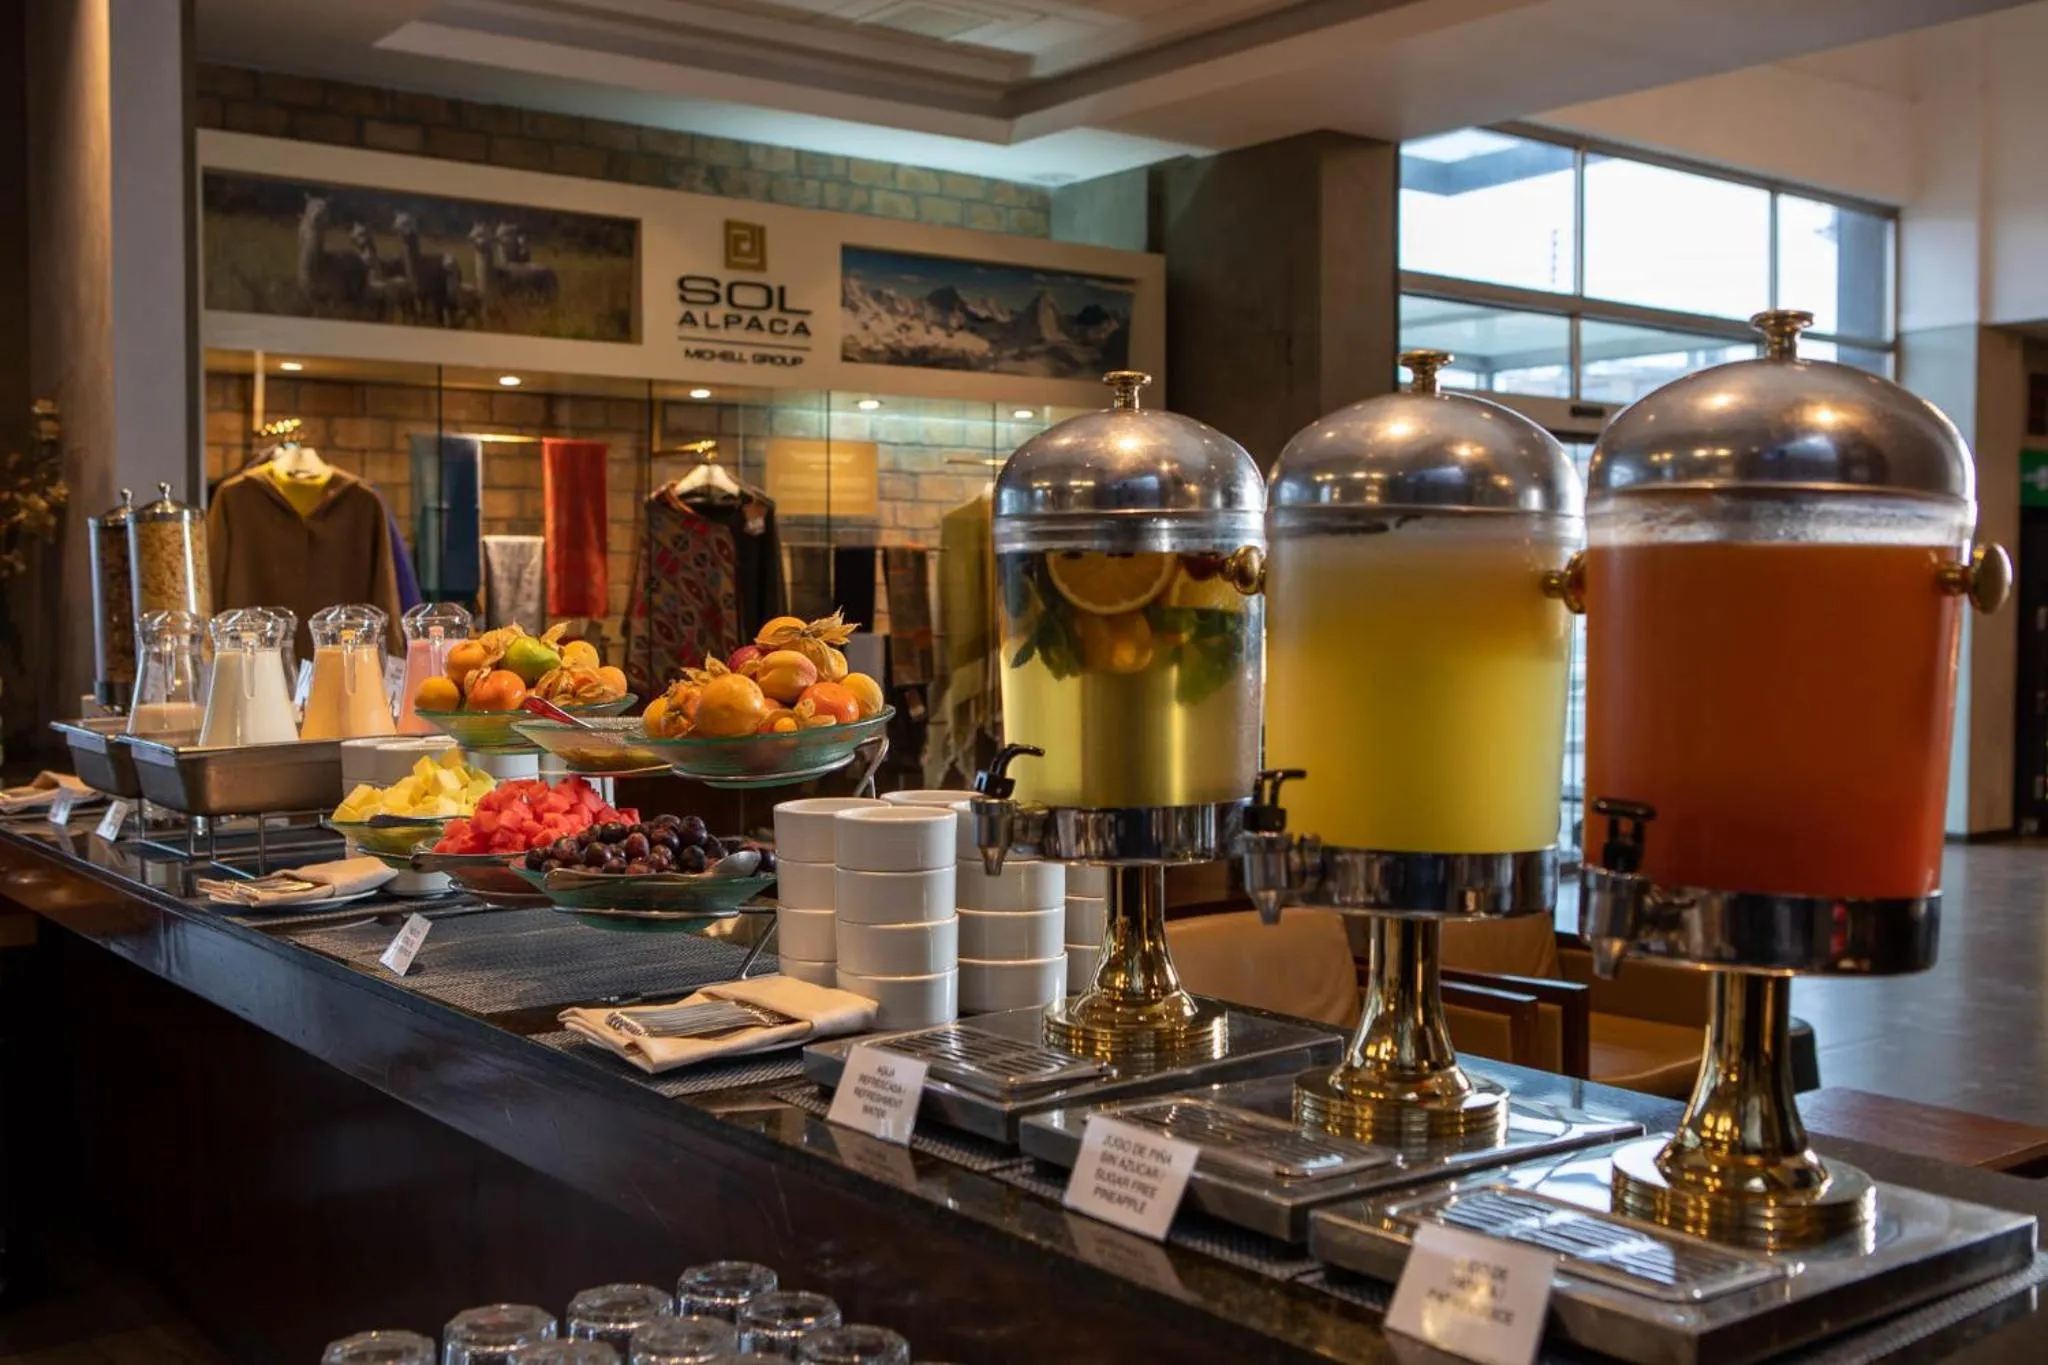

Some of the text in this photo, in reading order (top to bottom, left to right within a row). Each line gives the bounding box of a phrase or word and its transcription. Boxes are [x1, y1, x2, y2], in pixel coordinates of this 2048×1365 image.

[678, 275, 812, 315] SOL
[678, 310, 811, 337] ALPACA
[684, 348, 805, 367] MICHELL GROUP
[1100, 1150, 1117, 1165] SIN
[1132, 1142, 1148, 1157] DE
[1095, 1167, 1159, 1200] SUGAR FREE
[1093, 1186, 1147, 1215] PINEAPPLE
